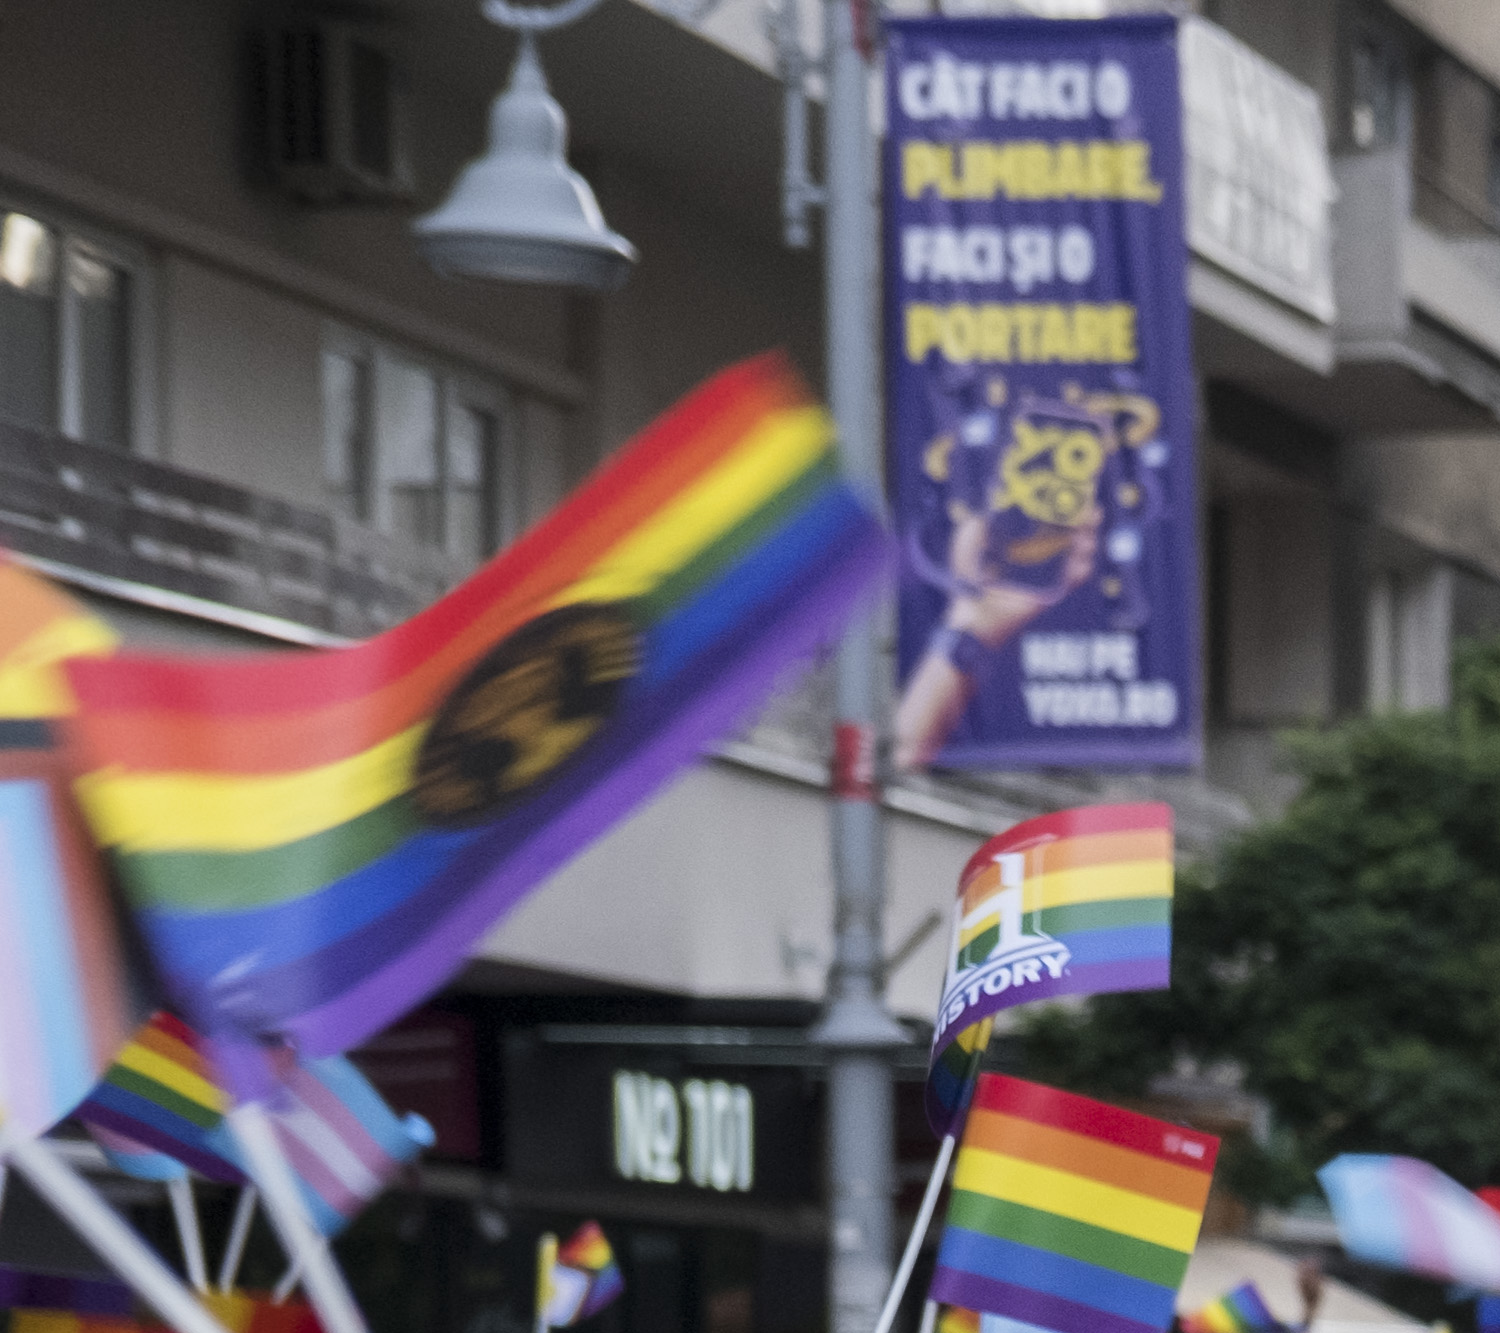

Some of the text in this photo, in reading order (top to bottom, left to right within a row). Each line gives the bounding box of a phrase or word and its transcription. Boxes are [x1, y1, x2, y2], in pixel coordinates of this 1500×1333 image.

[902, 53, 1130, 120] CÂT FACI O
[903, 227, 994, 282] FACI
[1058, 227, 1094, 280] O
[905, 304, 1136, 363] PORTARE
